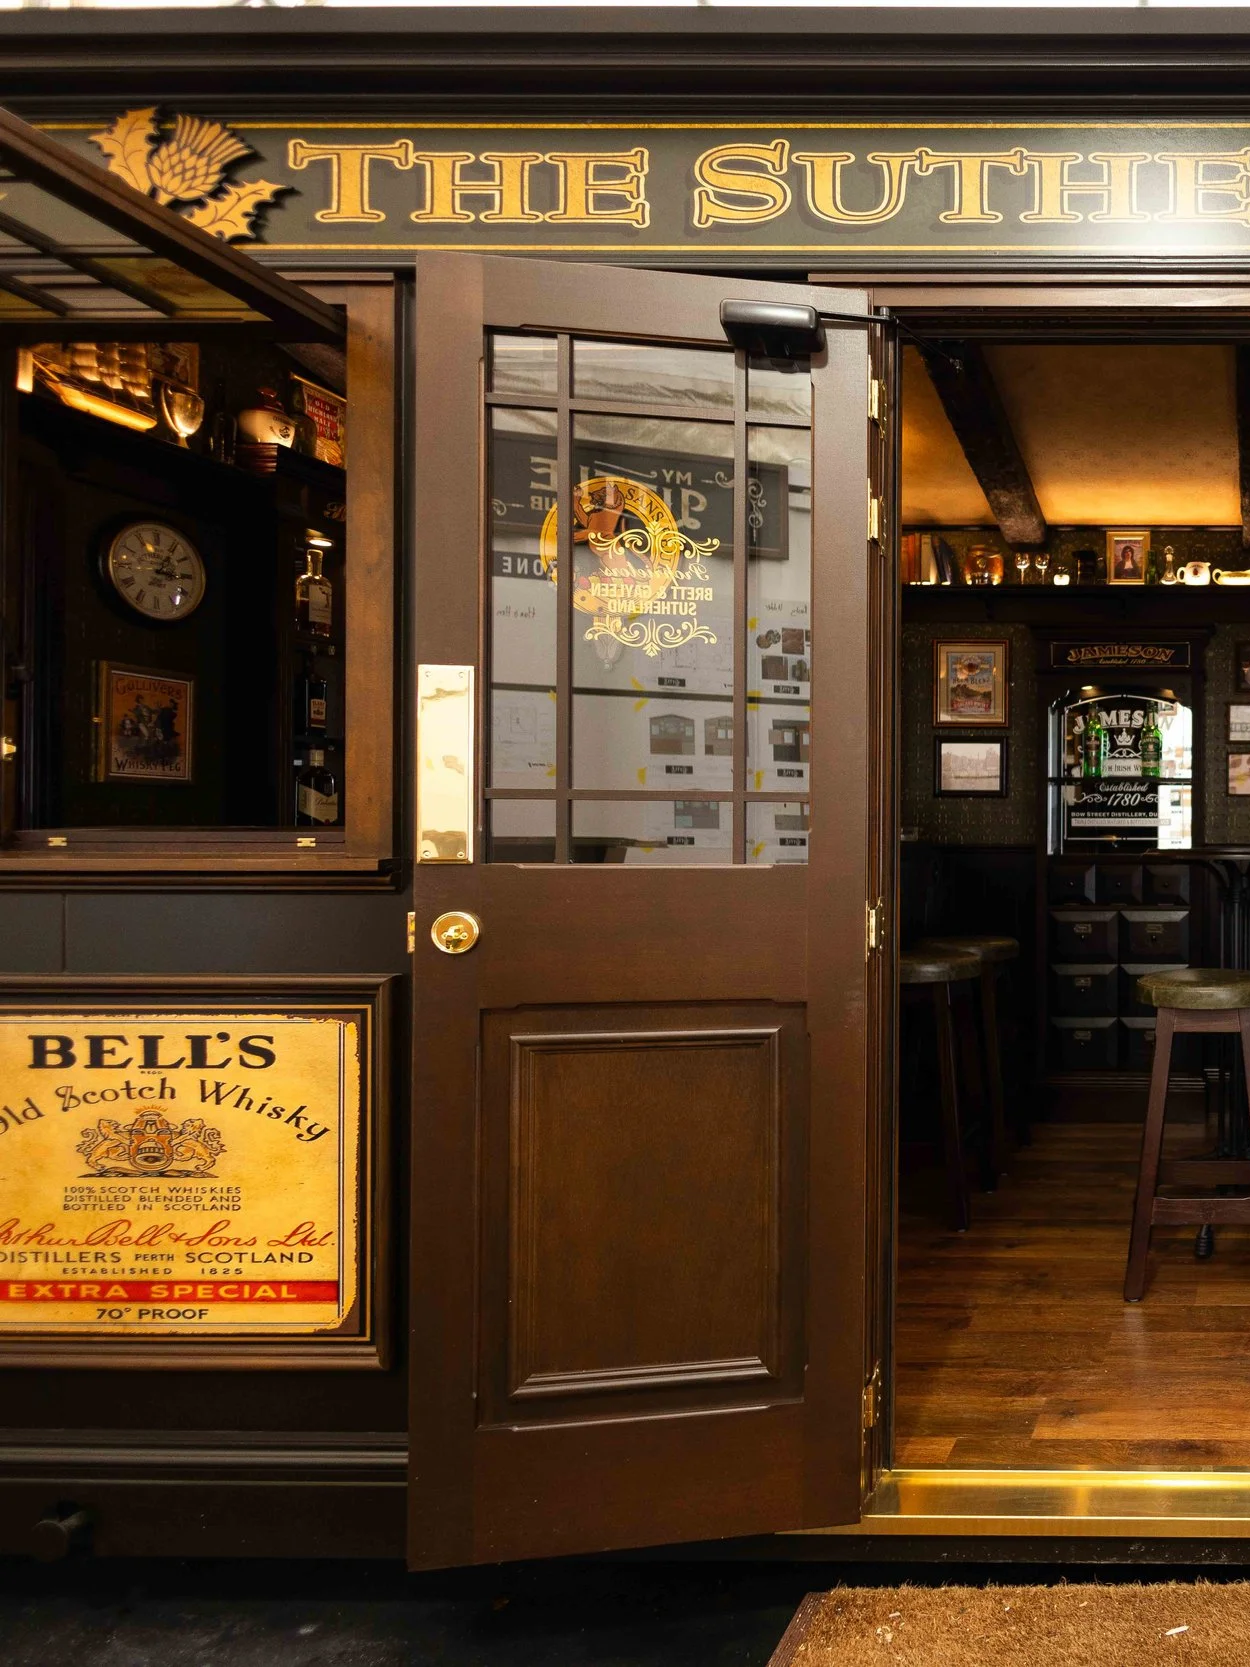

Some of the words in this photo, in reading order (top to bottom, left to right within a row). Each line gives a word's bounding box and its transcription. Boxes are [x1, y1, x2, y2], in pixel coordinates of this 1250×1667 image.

[288, 138, 651, 228] THE
[1067, 644, 1175, 662] JAMESON
[1106, 792, 1141, 807] 1780
[28, 1032, 277, 1070] BELL'S
[55, 1077, 176, 1112] Scotch
[199, 1078, 331, 1144] Whisky
[64, 1186, 96, 1194] 100%
[100, 1186, 160, 1194] SCOTCH
[168, 1186, 242, 1194] WHISKIES
[64, 1195, 132, 1203] DISTILLED
[139, 1195, 204, 1203] BLENDED
[210, 1195, 242, 1203] AND
[63, 1203, 126, 1212] BOTTLED
[137, 1203, 153, 1212] IN
[164, 1203, 242, 1212] SCOTLAND
[85, 1218, 165, 1247] Bell
[190, 1219, 258, 1248] Sons
[135, 1253, 175, 1262] PERTH
[185, 1251, 314, 1264] SCOTLAND
[63, 1267, 173, 1275] ESTABLISHED
[201, 1267, 244, 1275] 1825
[9, 1284, 128, 1300] EXTRA
[151, 1284, 297, 1300] SPECIAL
[96, 1307, 132, 1320] 70°
[138, 1308, 209, 1320] PROOF
